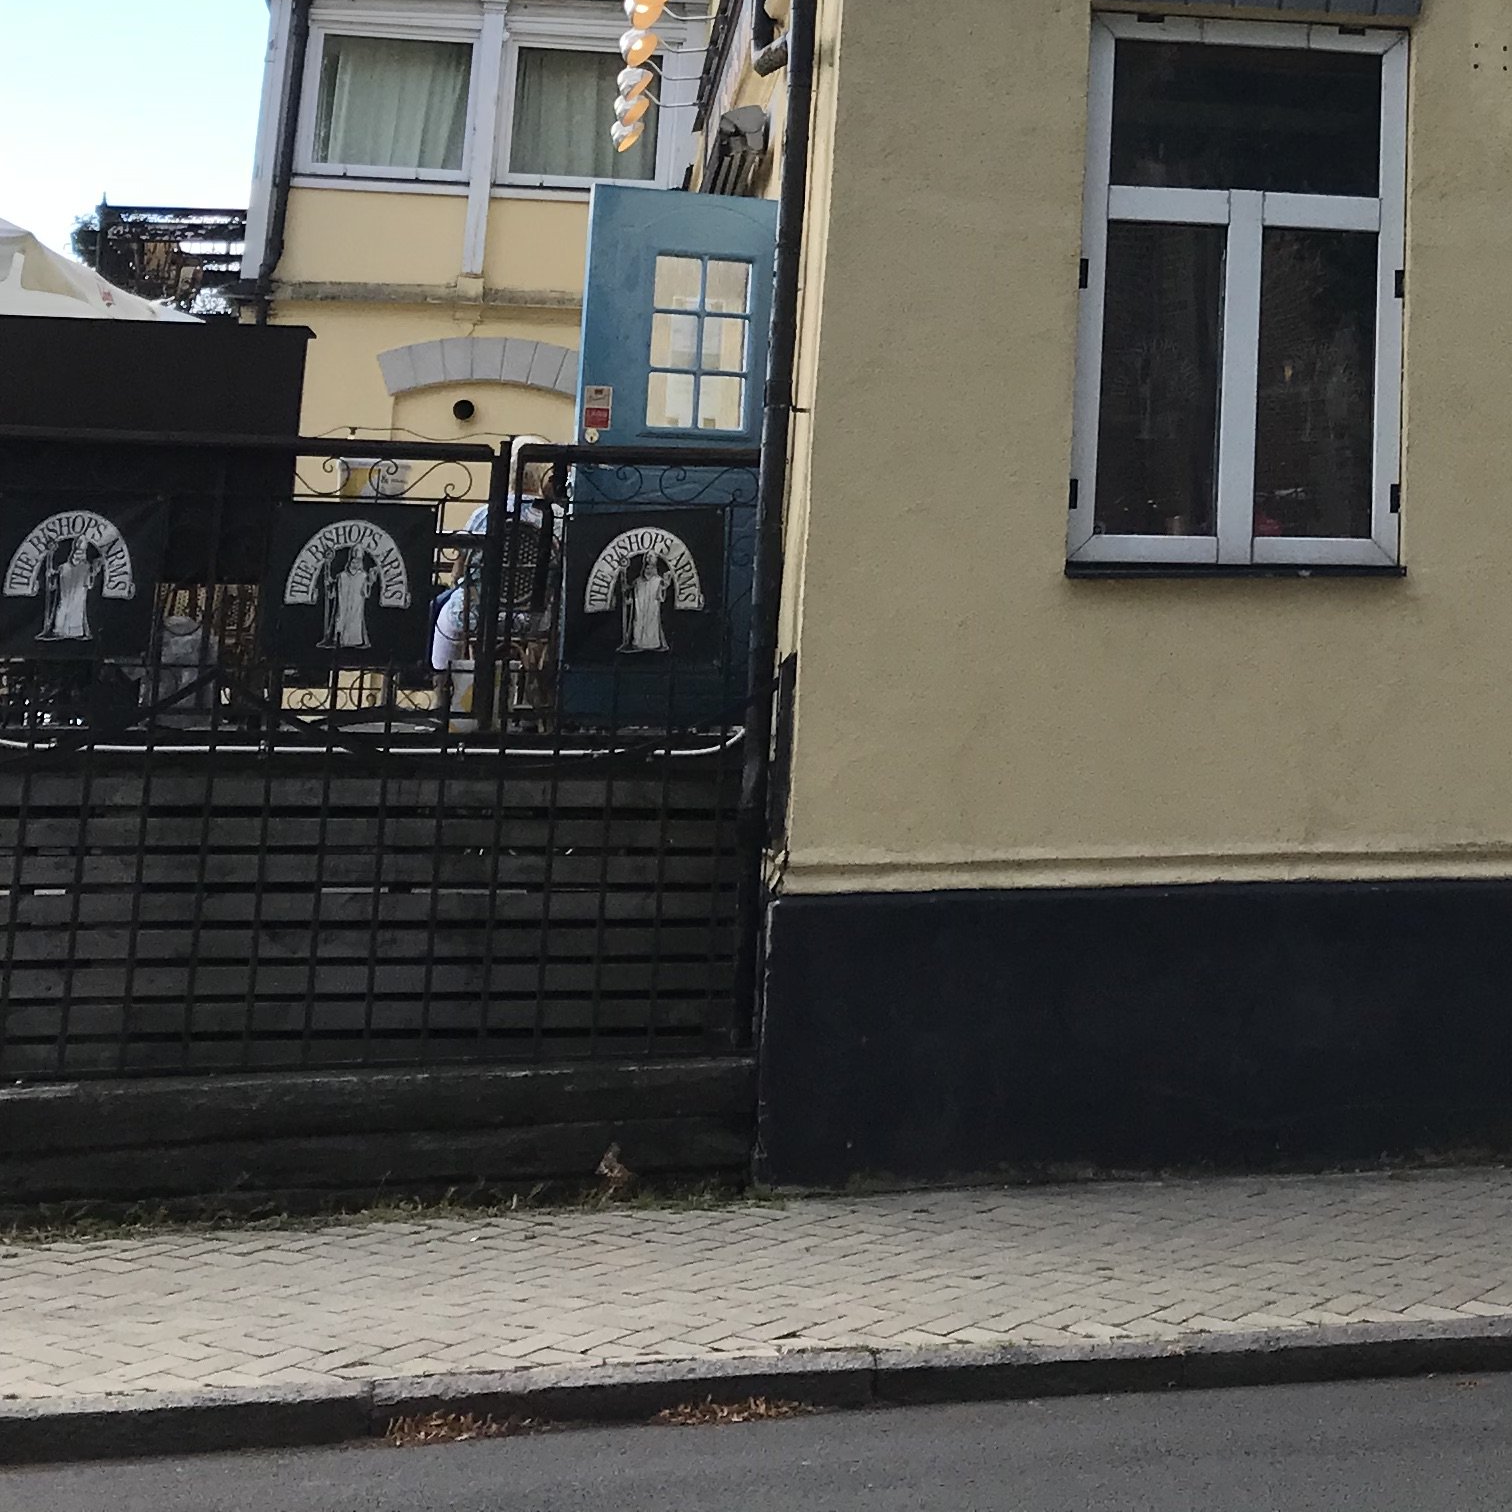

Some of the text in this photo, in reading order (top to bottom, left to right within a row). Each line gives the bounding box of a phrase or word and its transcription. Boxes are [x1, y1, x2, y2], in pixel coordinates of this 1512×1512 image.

[9, 513, 129, 592] THE BISHOPS ARMS
[289, 523, 404, 601] THE BISHOPS ARMS
[588, 531, 698, 607] THE BISHOPS ARMS
